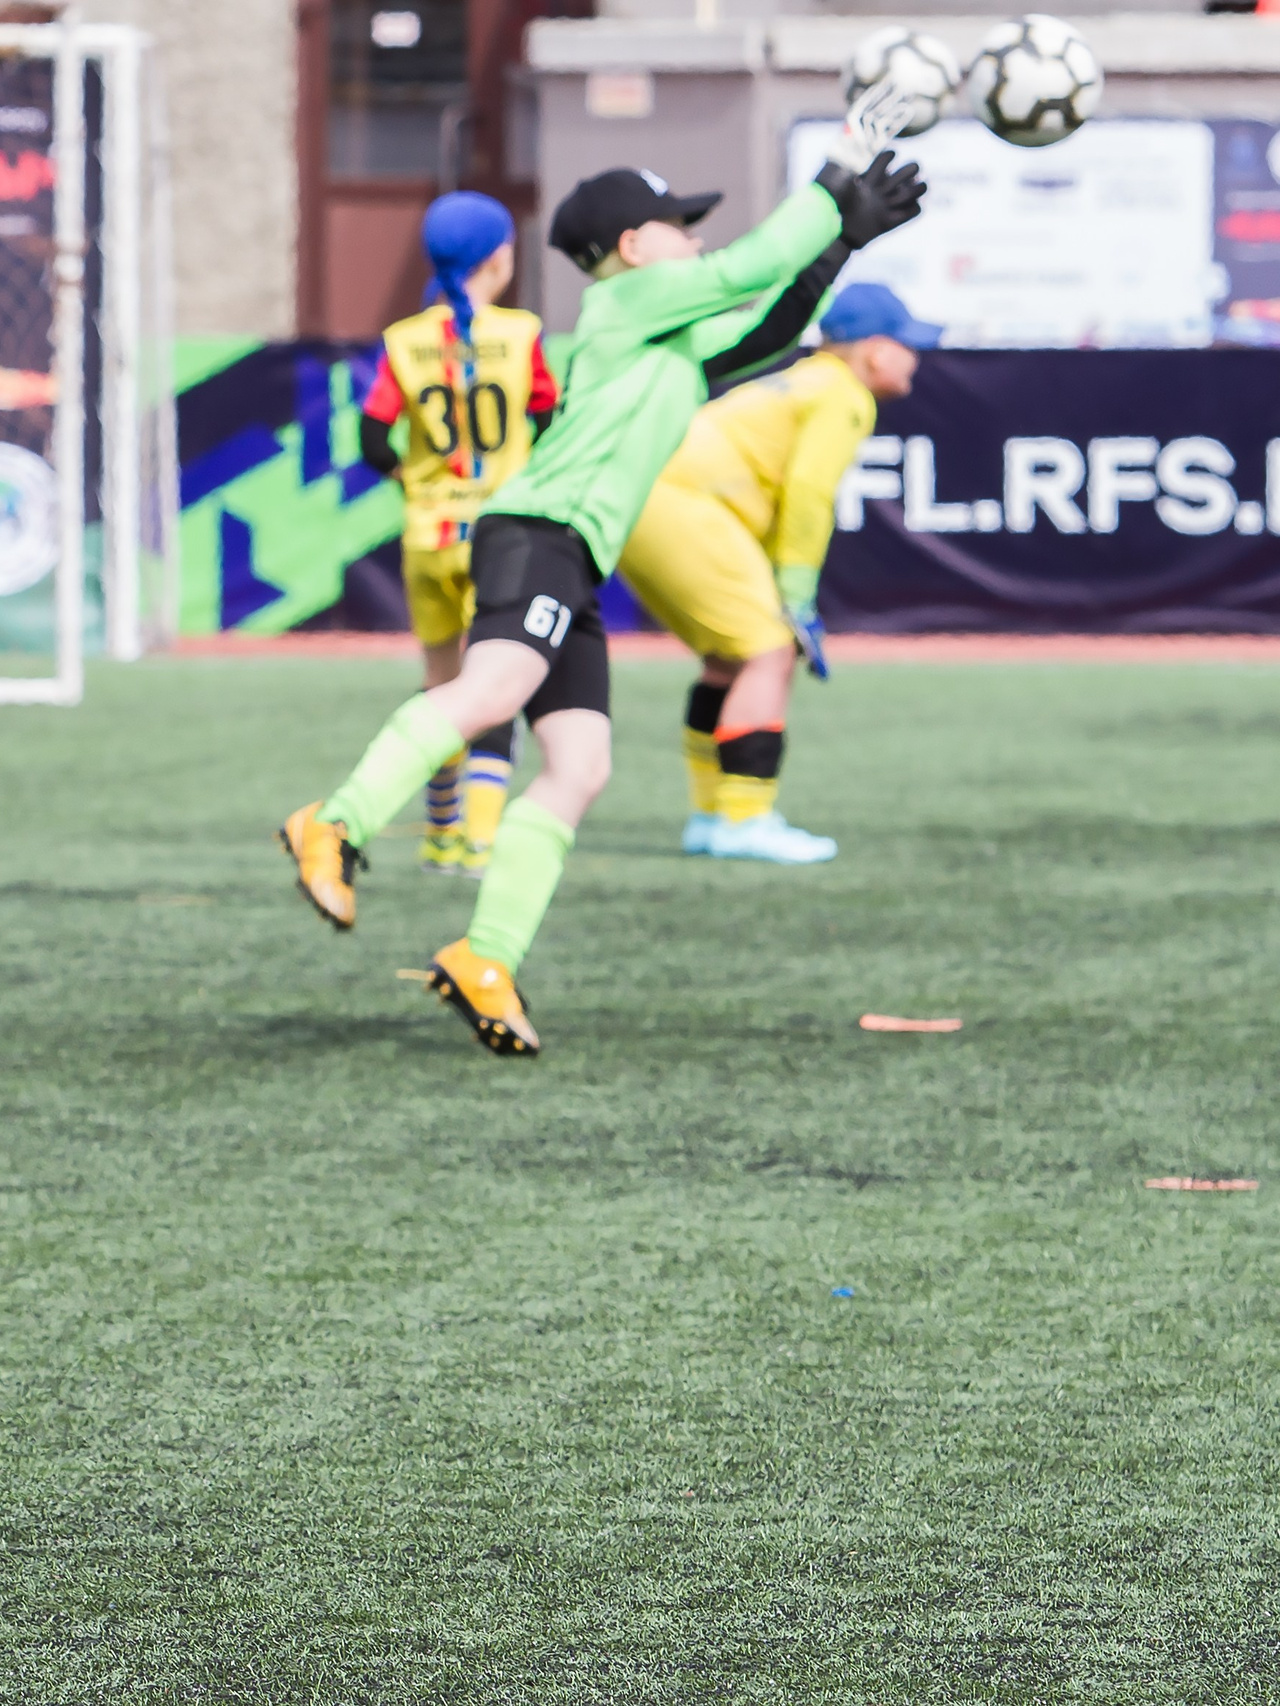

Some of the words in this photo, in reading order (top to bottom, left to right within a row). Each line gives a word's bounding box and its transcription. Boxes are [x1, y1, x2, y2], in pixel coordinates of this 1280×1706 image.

[419, 382, 508, 457] 30
[835, 434, 1280, 537] FL.RFS.
[523, 594, 573, 649] 61
